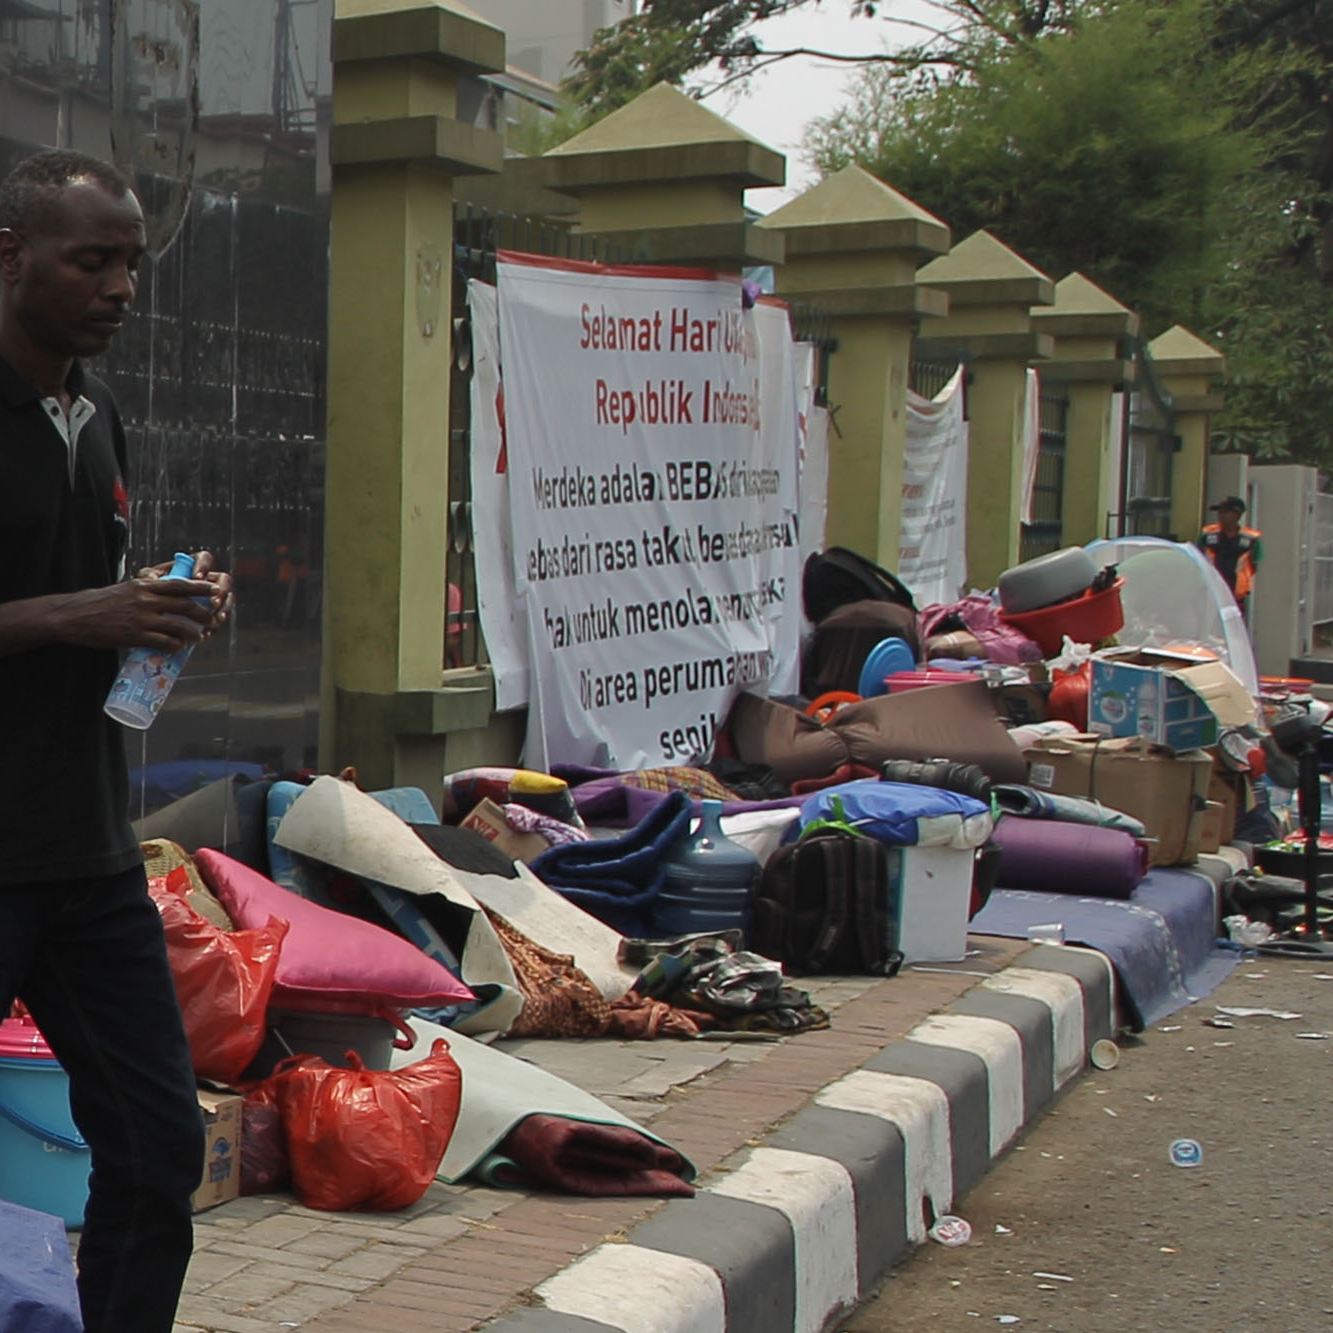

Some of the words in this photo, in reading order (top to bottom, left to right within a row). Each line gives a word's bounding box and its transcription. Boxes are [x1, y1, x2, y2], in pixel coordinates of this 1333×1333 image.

[580, 303, 662, 352] Selamat
[670, 308, 722, 352] Hari
[533, 465, 596, 510] Merdeka
[562, 532, 591, 578] dari
[594, 537, 637, 573] rasa
[625, 587, 719, 635] menola
[595, 670, 637, 708] area
